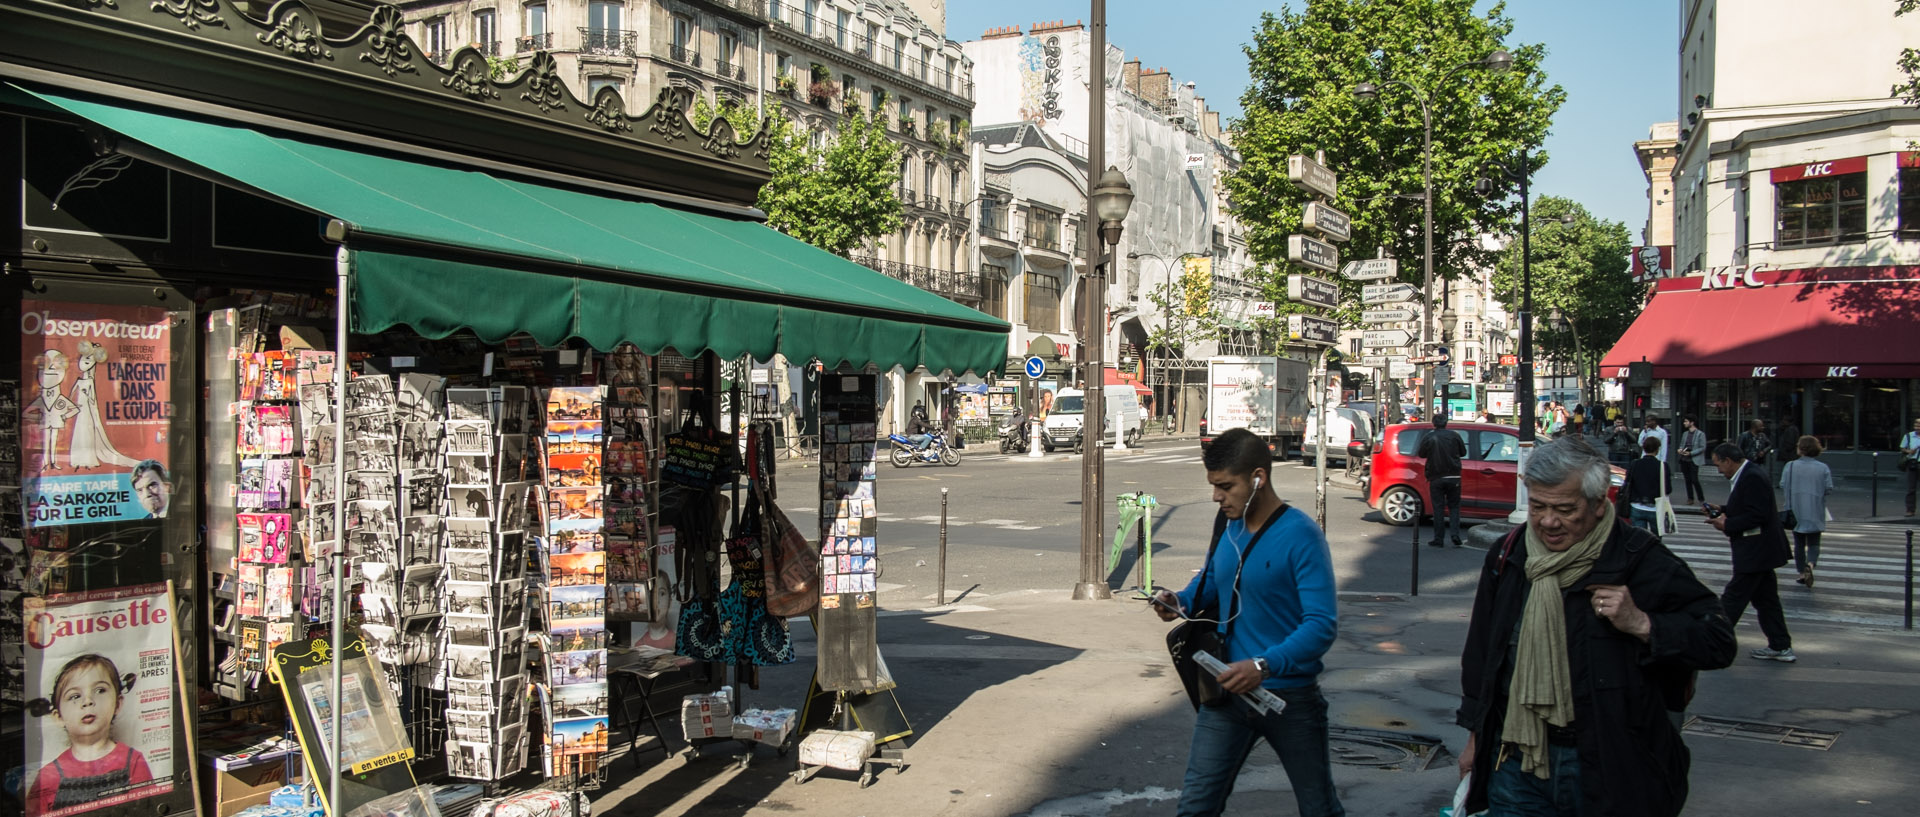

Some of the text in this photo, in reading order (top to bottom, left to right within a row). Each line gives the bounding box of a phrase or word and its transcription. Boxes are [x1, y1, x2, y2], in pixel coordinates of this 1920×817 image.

[1803, 162, 1832, 177] KFC
[1701, 263, 1768, 291] KFC
[21, 311, 169, 340] Observateur
[132, 345, 139, 353] ET
[107, 362, 166, 381] L'ARGENT
[1752, 366, 1778, 377] KFC
[1827, 366, 1858, 377] KFC
[1227, 377, 1252, 385] PARIS
[121, 382, 156, 401] DANS
[106, 402, 170, 420] LE COUPLE
[25, 480, 119, 495] AFFAIRE TAPIE
[26, 491, 130, 508] LA SARKOZIE
[27, 505, 122, 522] SUR LE GRIL
[28, 599, 167, 649] Causette
[141, 667, 165, 678] APRÈS
[361, 750, 408, 771] en vente ici
[137, 786, 160, 797] CHAQUE
